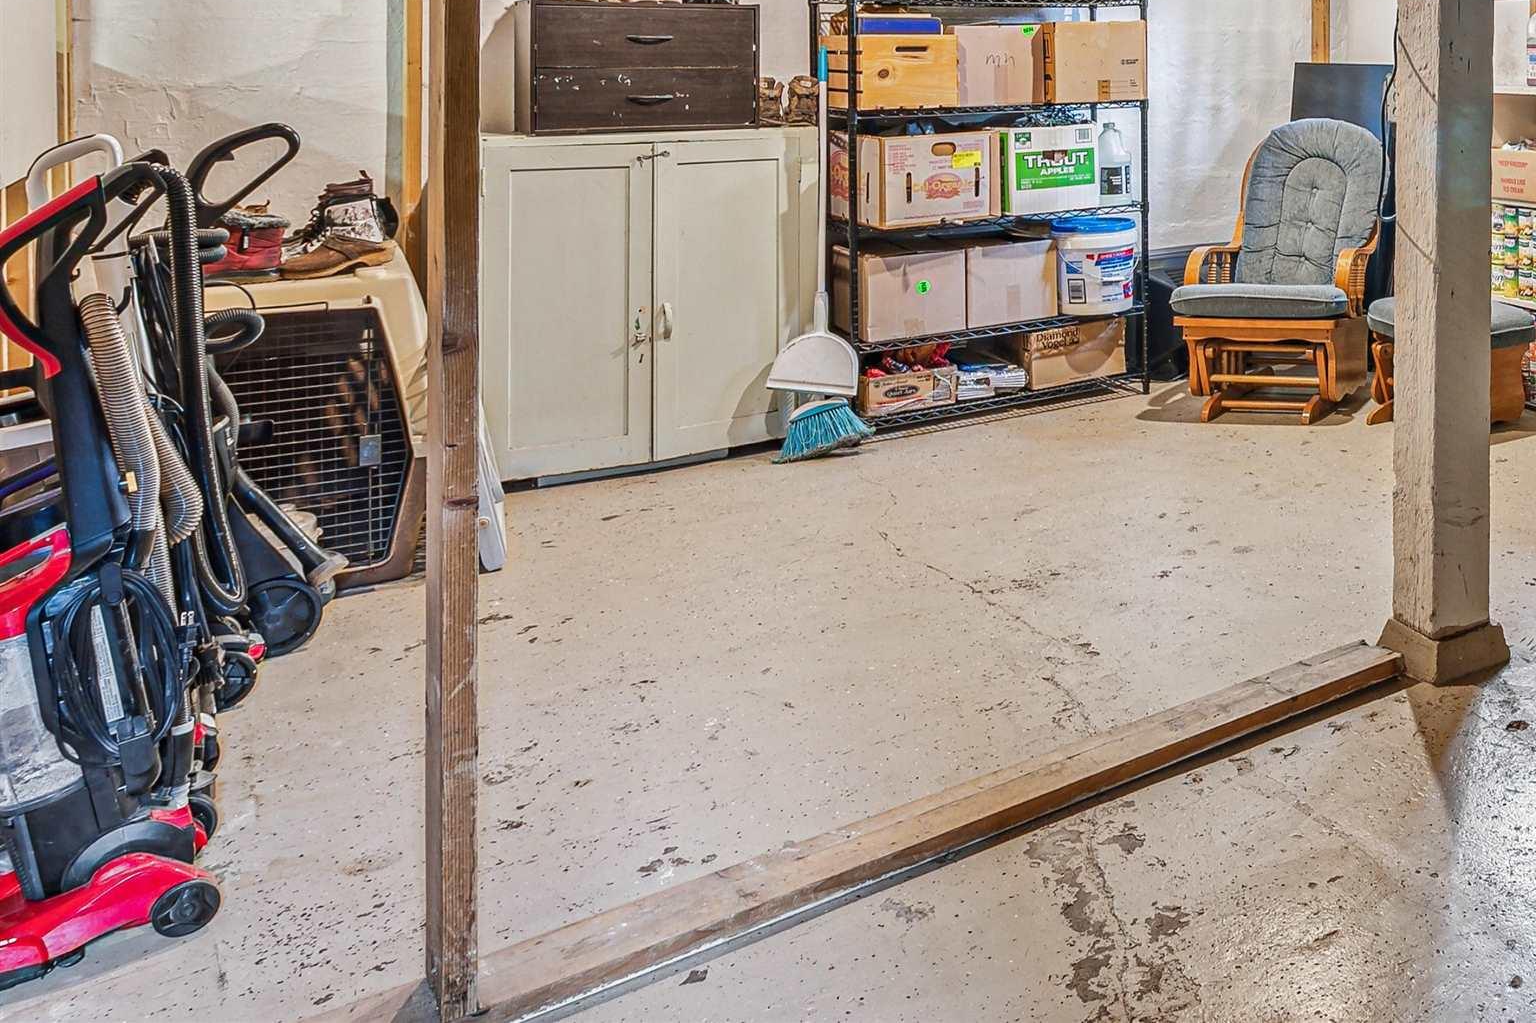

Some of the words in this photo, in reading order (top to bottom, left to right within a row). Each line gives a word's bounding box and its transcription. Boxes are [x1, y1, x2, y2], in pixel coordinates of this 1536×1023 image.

[1023, 151, 1088, 169] TRUT
[1040, 166, 1075, 176] APPLES
[1037, 328, 1080, 342] Diamond
[1042, 338, 1067, 349] Vogel
